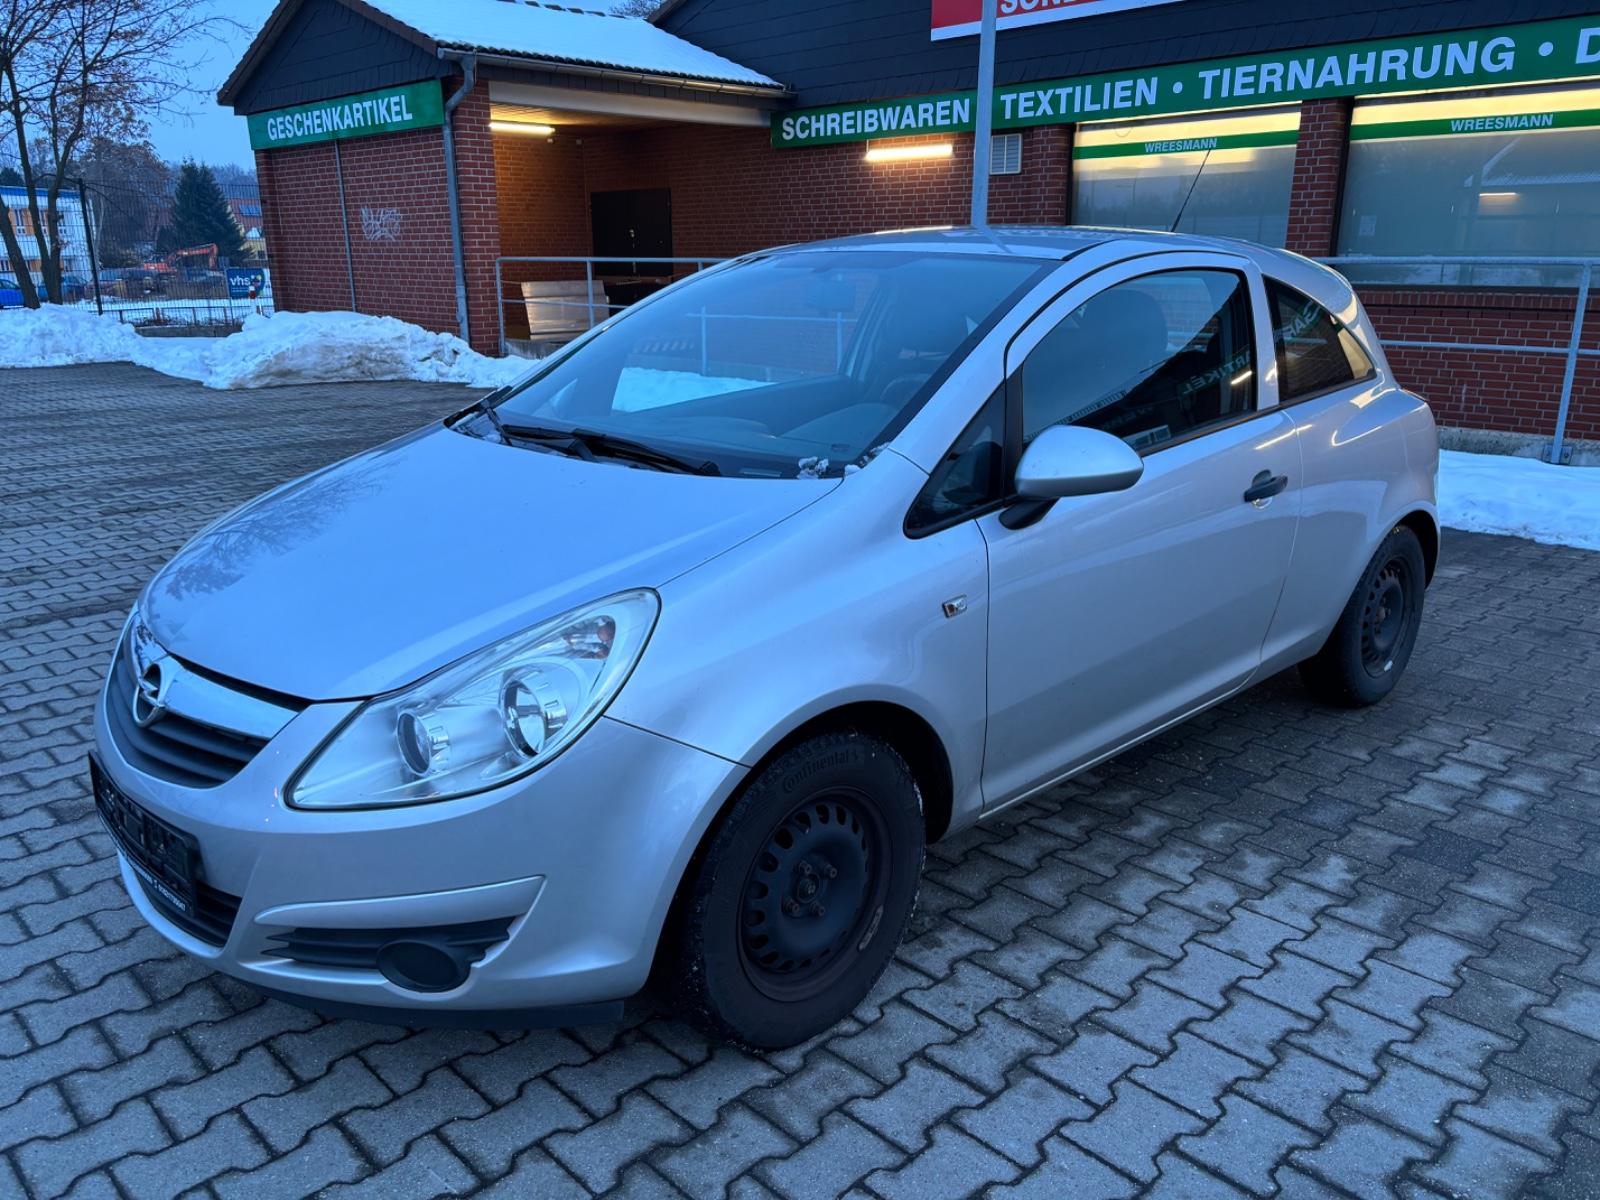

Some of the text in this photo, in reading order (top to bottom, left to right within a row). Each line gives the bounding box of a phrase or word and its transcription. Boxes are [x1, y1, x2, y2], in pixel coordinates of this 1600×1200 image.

[781, 99, 971, 141] SCHREIBWAREN
[1000, 77, 1159, 121] TEXTILIEN
[1198, 36, 1516, 101] TIERNAHRUNG
[267, 95, 413, 141] GESCHENKARTIKEL
[1450, 113, 1554, 132] WREESMANN
[1144, 137, 1218, 153] WREESMANN
[230, 275, 250, 286] vhs
